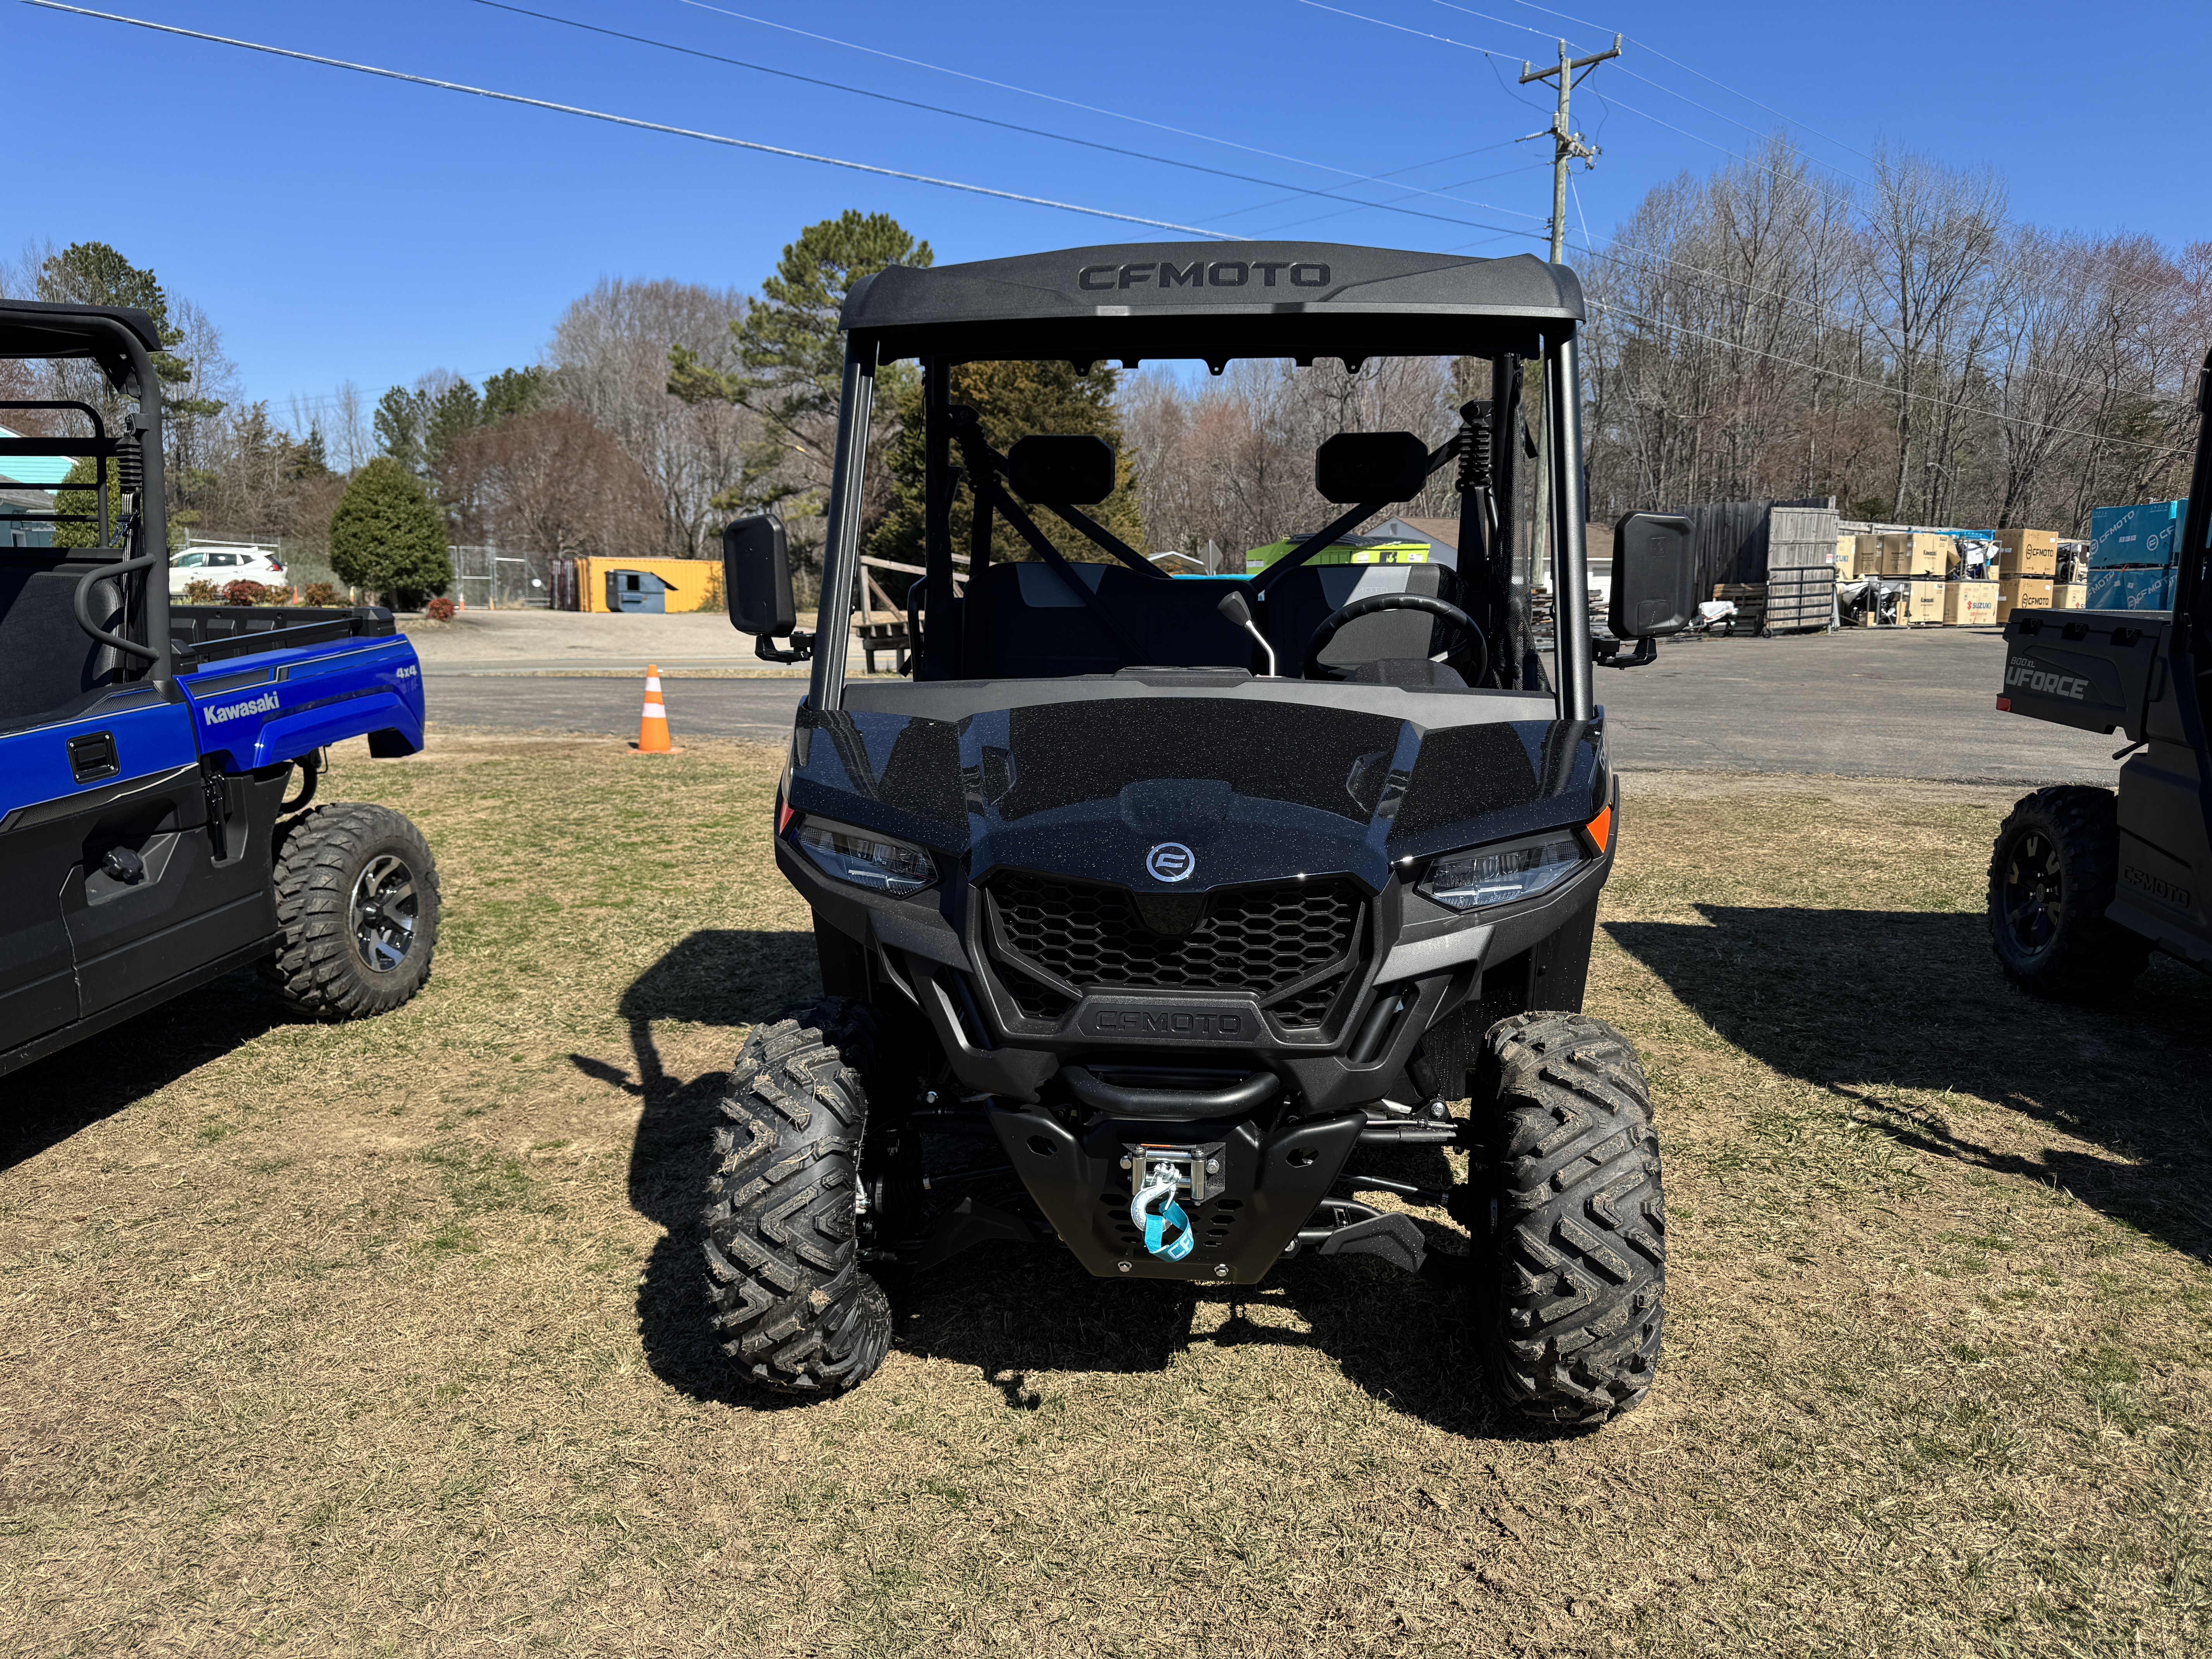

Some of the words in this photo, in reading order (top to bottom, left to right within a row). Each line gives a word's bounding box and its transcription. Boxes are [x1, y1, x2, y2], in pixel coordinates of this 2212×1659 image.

[1078, 261, 1331, 290] CFMOTO
[2099, 510, 2135, 544] CFMOTO
[2032, 548, 2053, 557] CFMOTO
[2087, 571, 2114, 598] FMOTO
[2137, 575, 2168, 601] CFMOT
[396, 665, 417, 678] 4x4
[2006, 666, 2089, 699] UFORCE
[203, 691, 280, 726] Kawasaki
[2124, 865, 2190, 908] CFMOTO
[1096, 1010, 1240, 1034] CFMOTO
